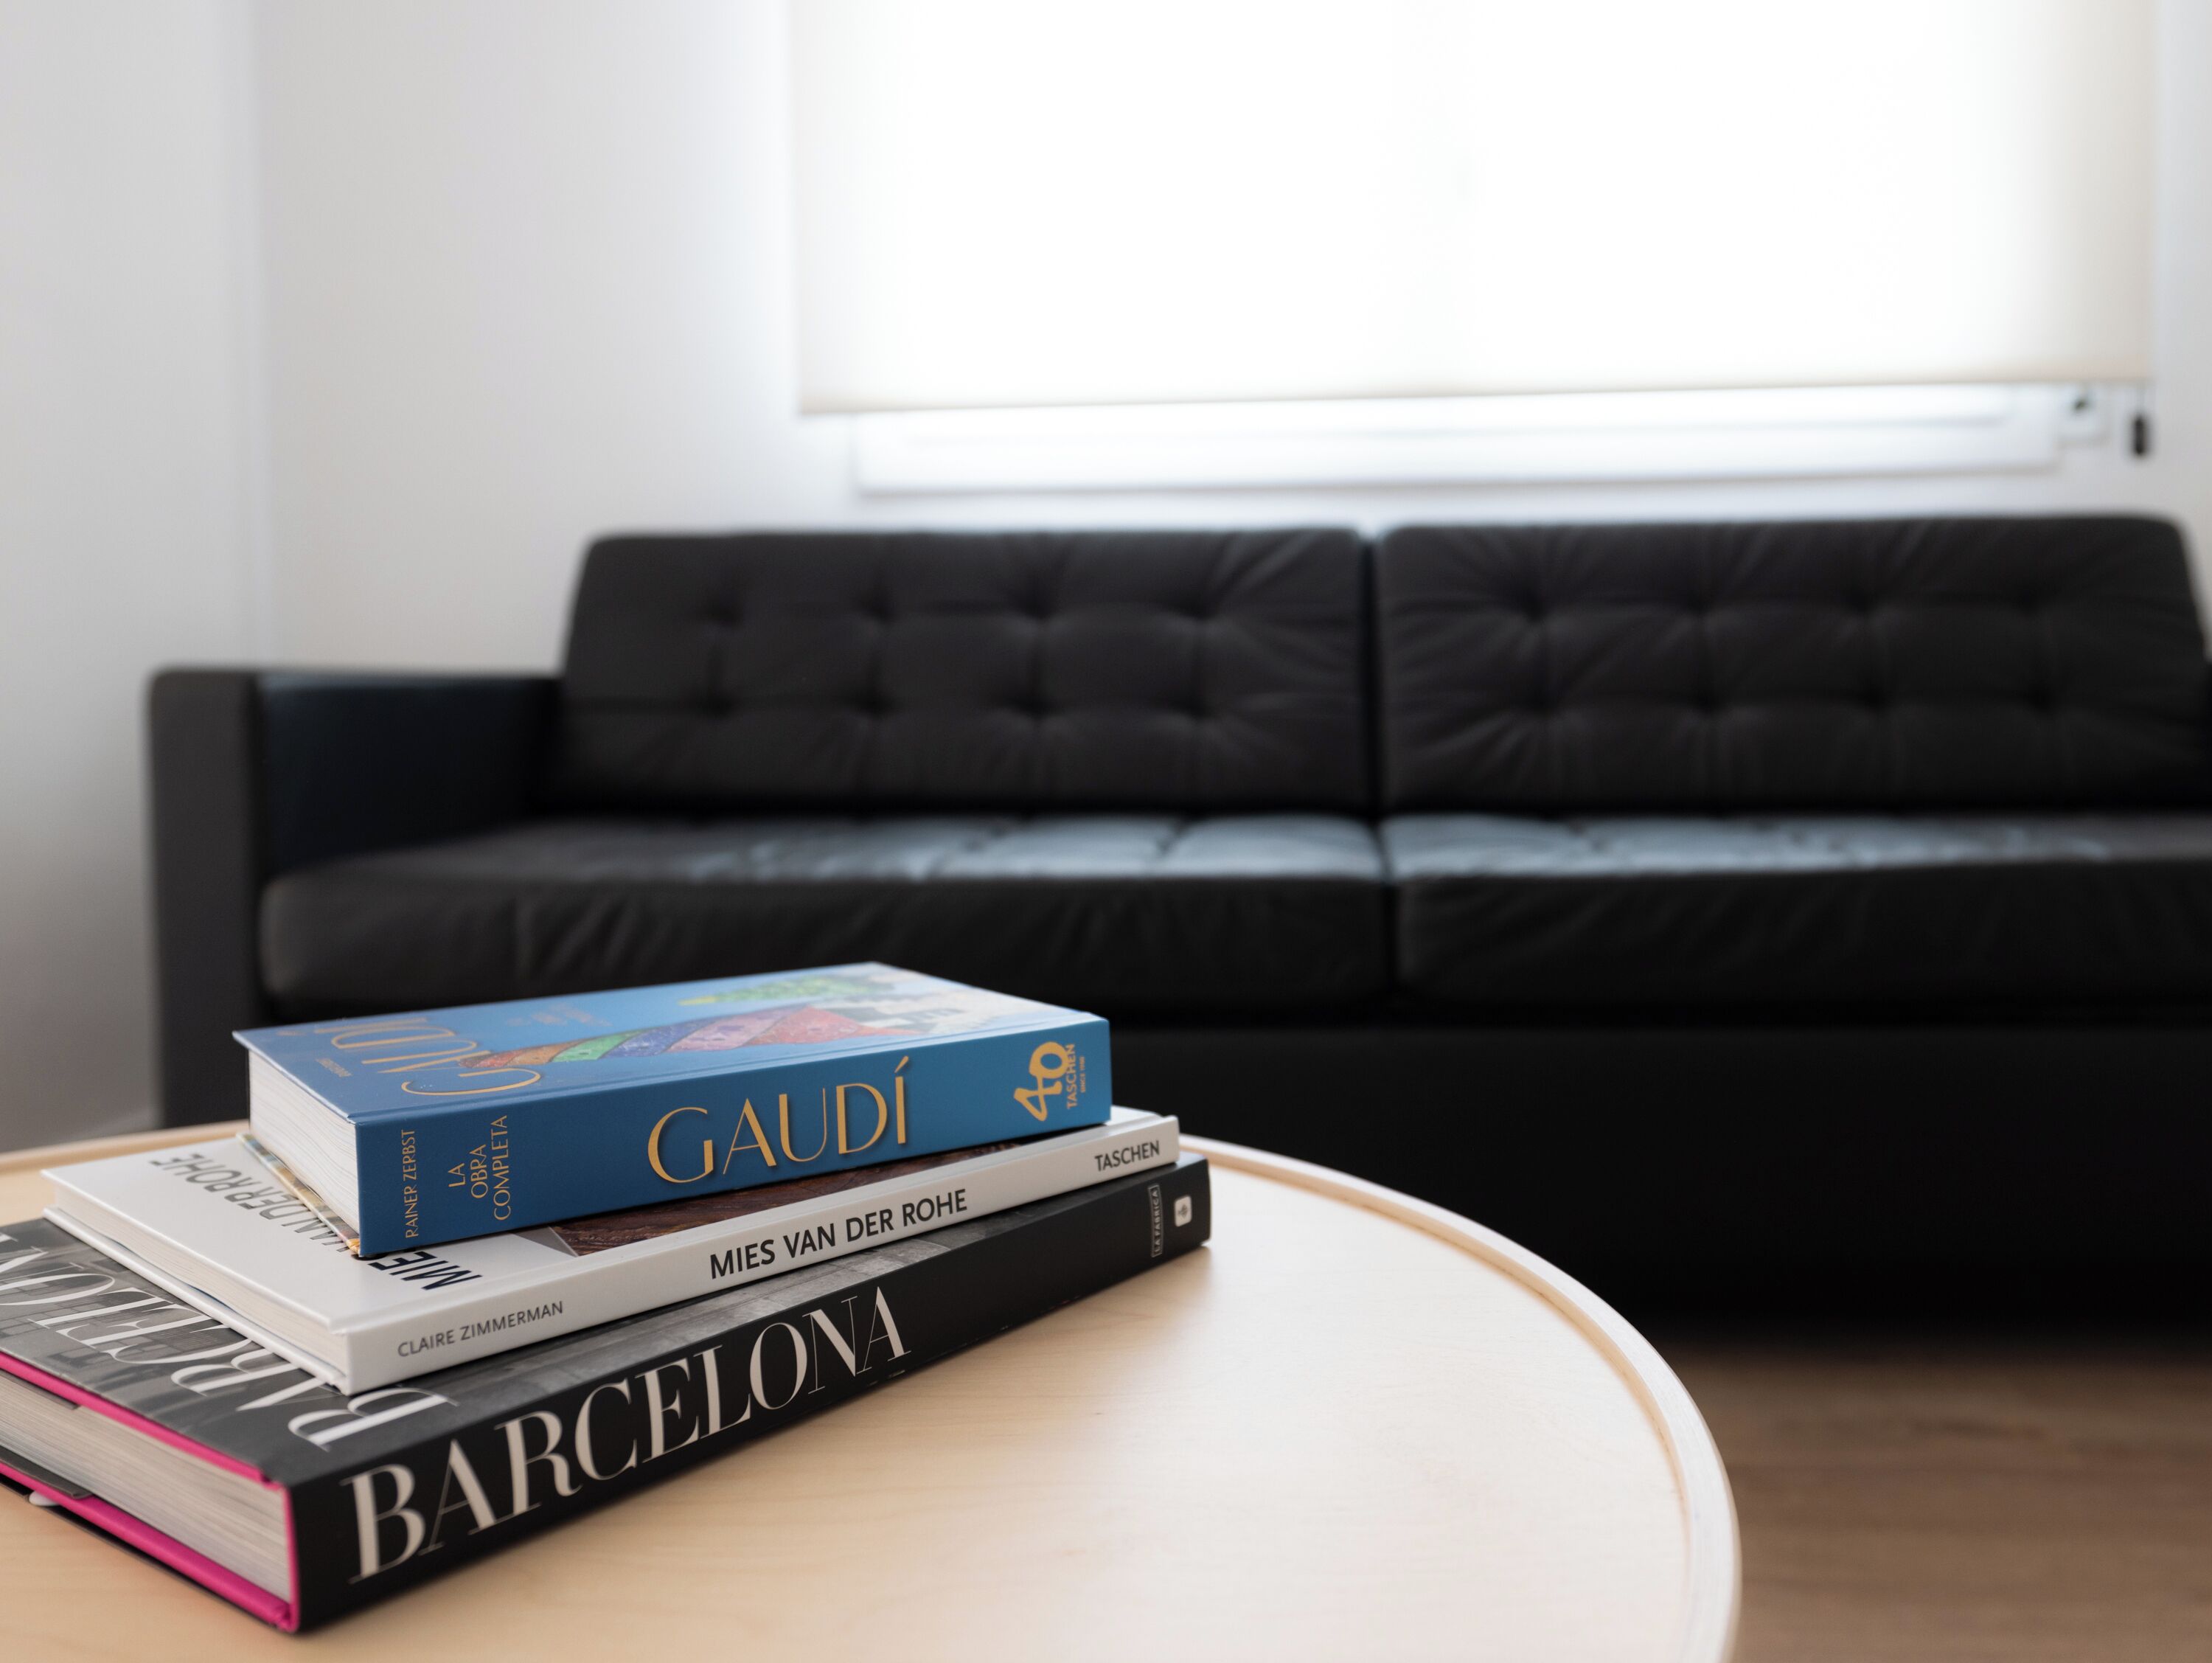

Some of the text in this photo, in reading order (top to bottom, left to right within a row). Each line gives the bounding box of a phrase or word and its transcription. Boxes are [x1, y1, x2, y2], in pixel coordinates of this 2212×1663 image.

[1066, 1044, 1078, 1109] TASCHEN
[647, 1055, 909, 1184] GAUDÍ
[149, 1153, 261, 1192] ROHE
[401, 1128, 420, 1239] RAINER ZERBST
[448, 1162, 467, 1187] LA
[469, 1144, 489, 1198] OBRA
[490, 1114, 512, 1221] COMPLETA
[1095, 1140, 1160, 1172] TASCHEN
[710, 1188, 967, 1280] MIES VAN DER ROHE
[1154, 1239, 1161, 1253] LA
[397, 1300, 563, 1357] CLAIRE ZIMMERMAN
[339, 1285, 912, 1584] BARCELONA
